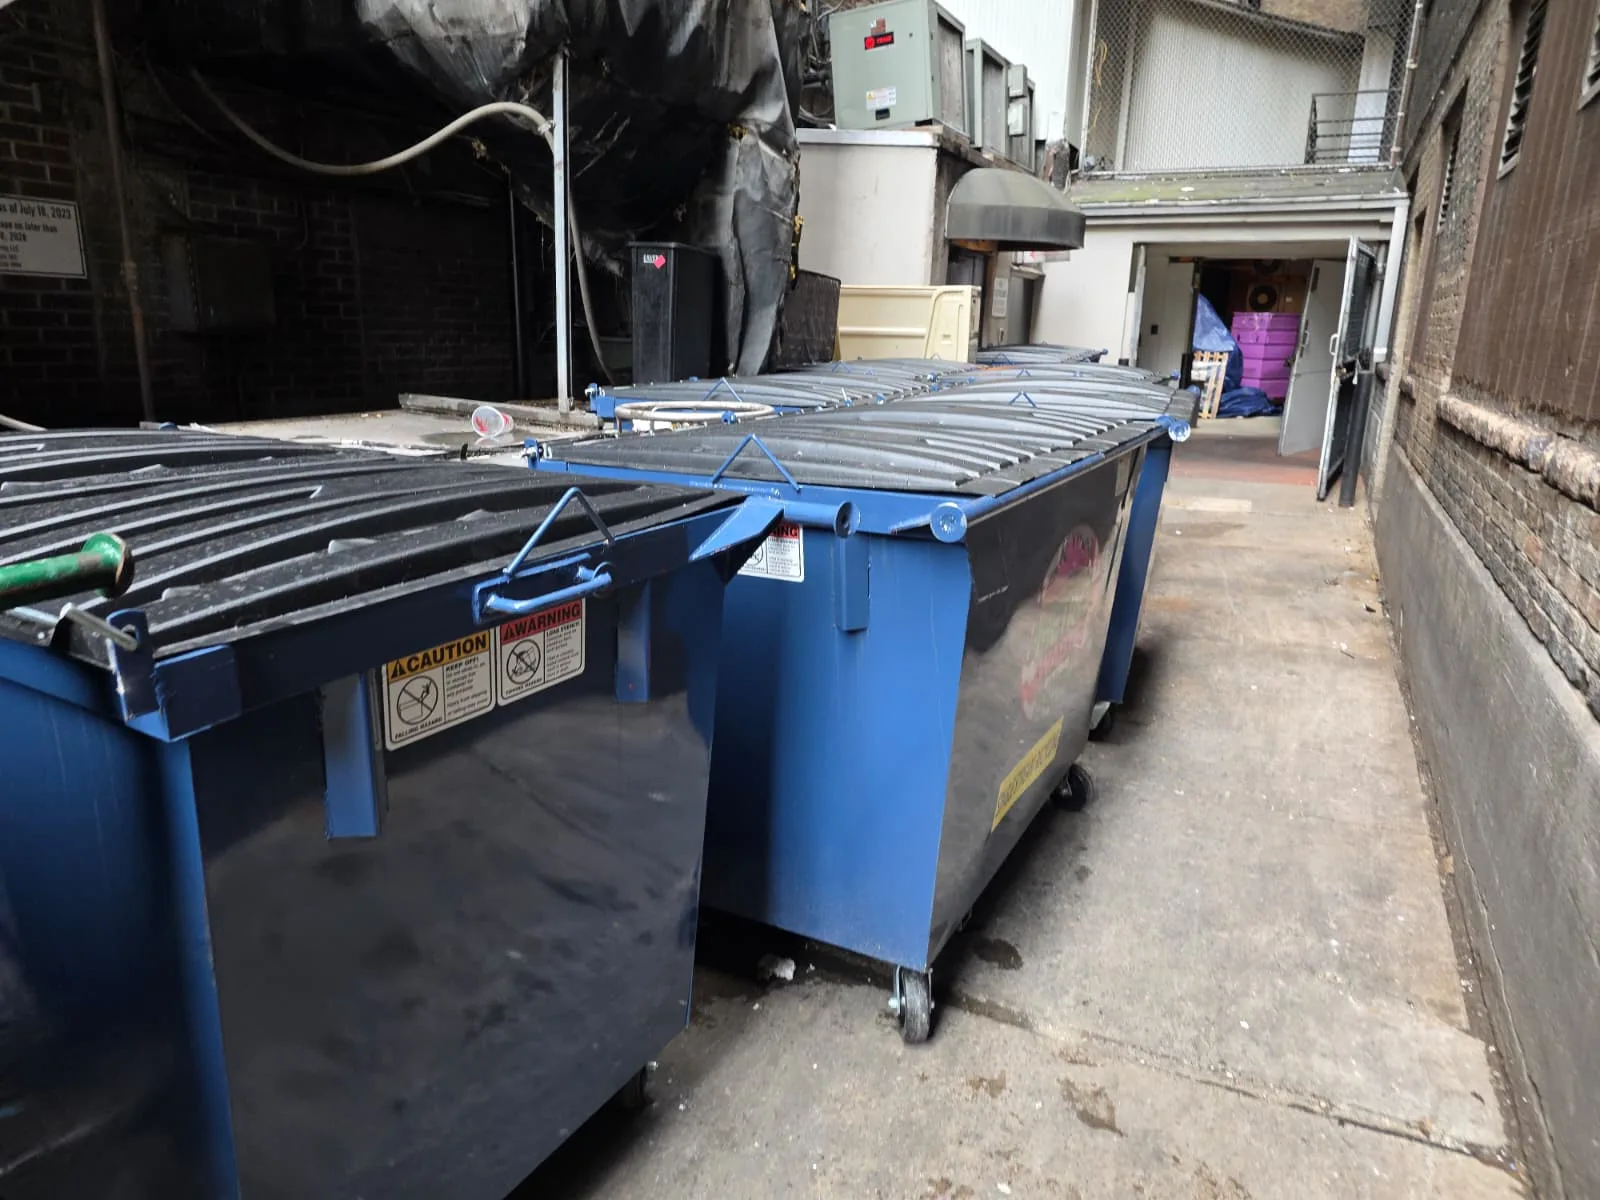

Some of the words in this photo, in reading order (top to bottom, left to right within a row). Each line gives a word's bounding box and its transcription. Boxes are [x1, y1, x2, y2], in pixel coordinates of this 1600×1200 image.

[20, 203, 35, 217] July
[50, 206, 71, 219] 2023
[25, 221, 41, 232] later
[515, 603, 580, 636] WARNING
[407, 634, 486, 672] CAUTION
[445, 661, 463, 672] KEEP
[394, 725, 419, 740] FALLING
[420, 716, 443, 729] HAZARD
